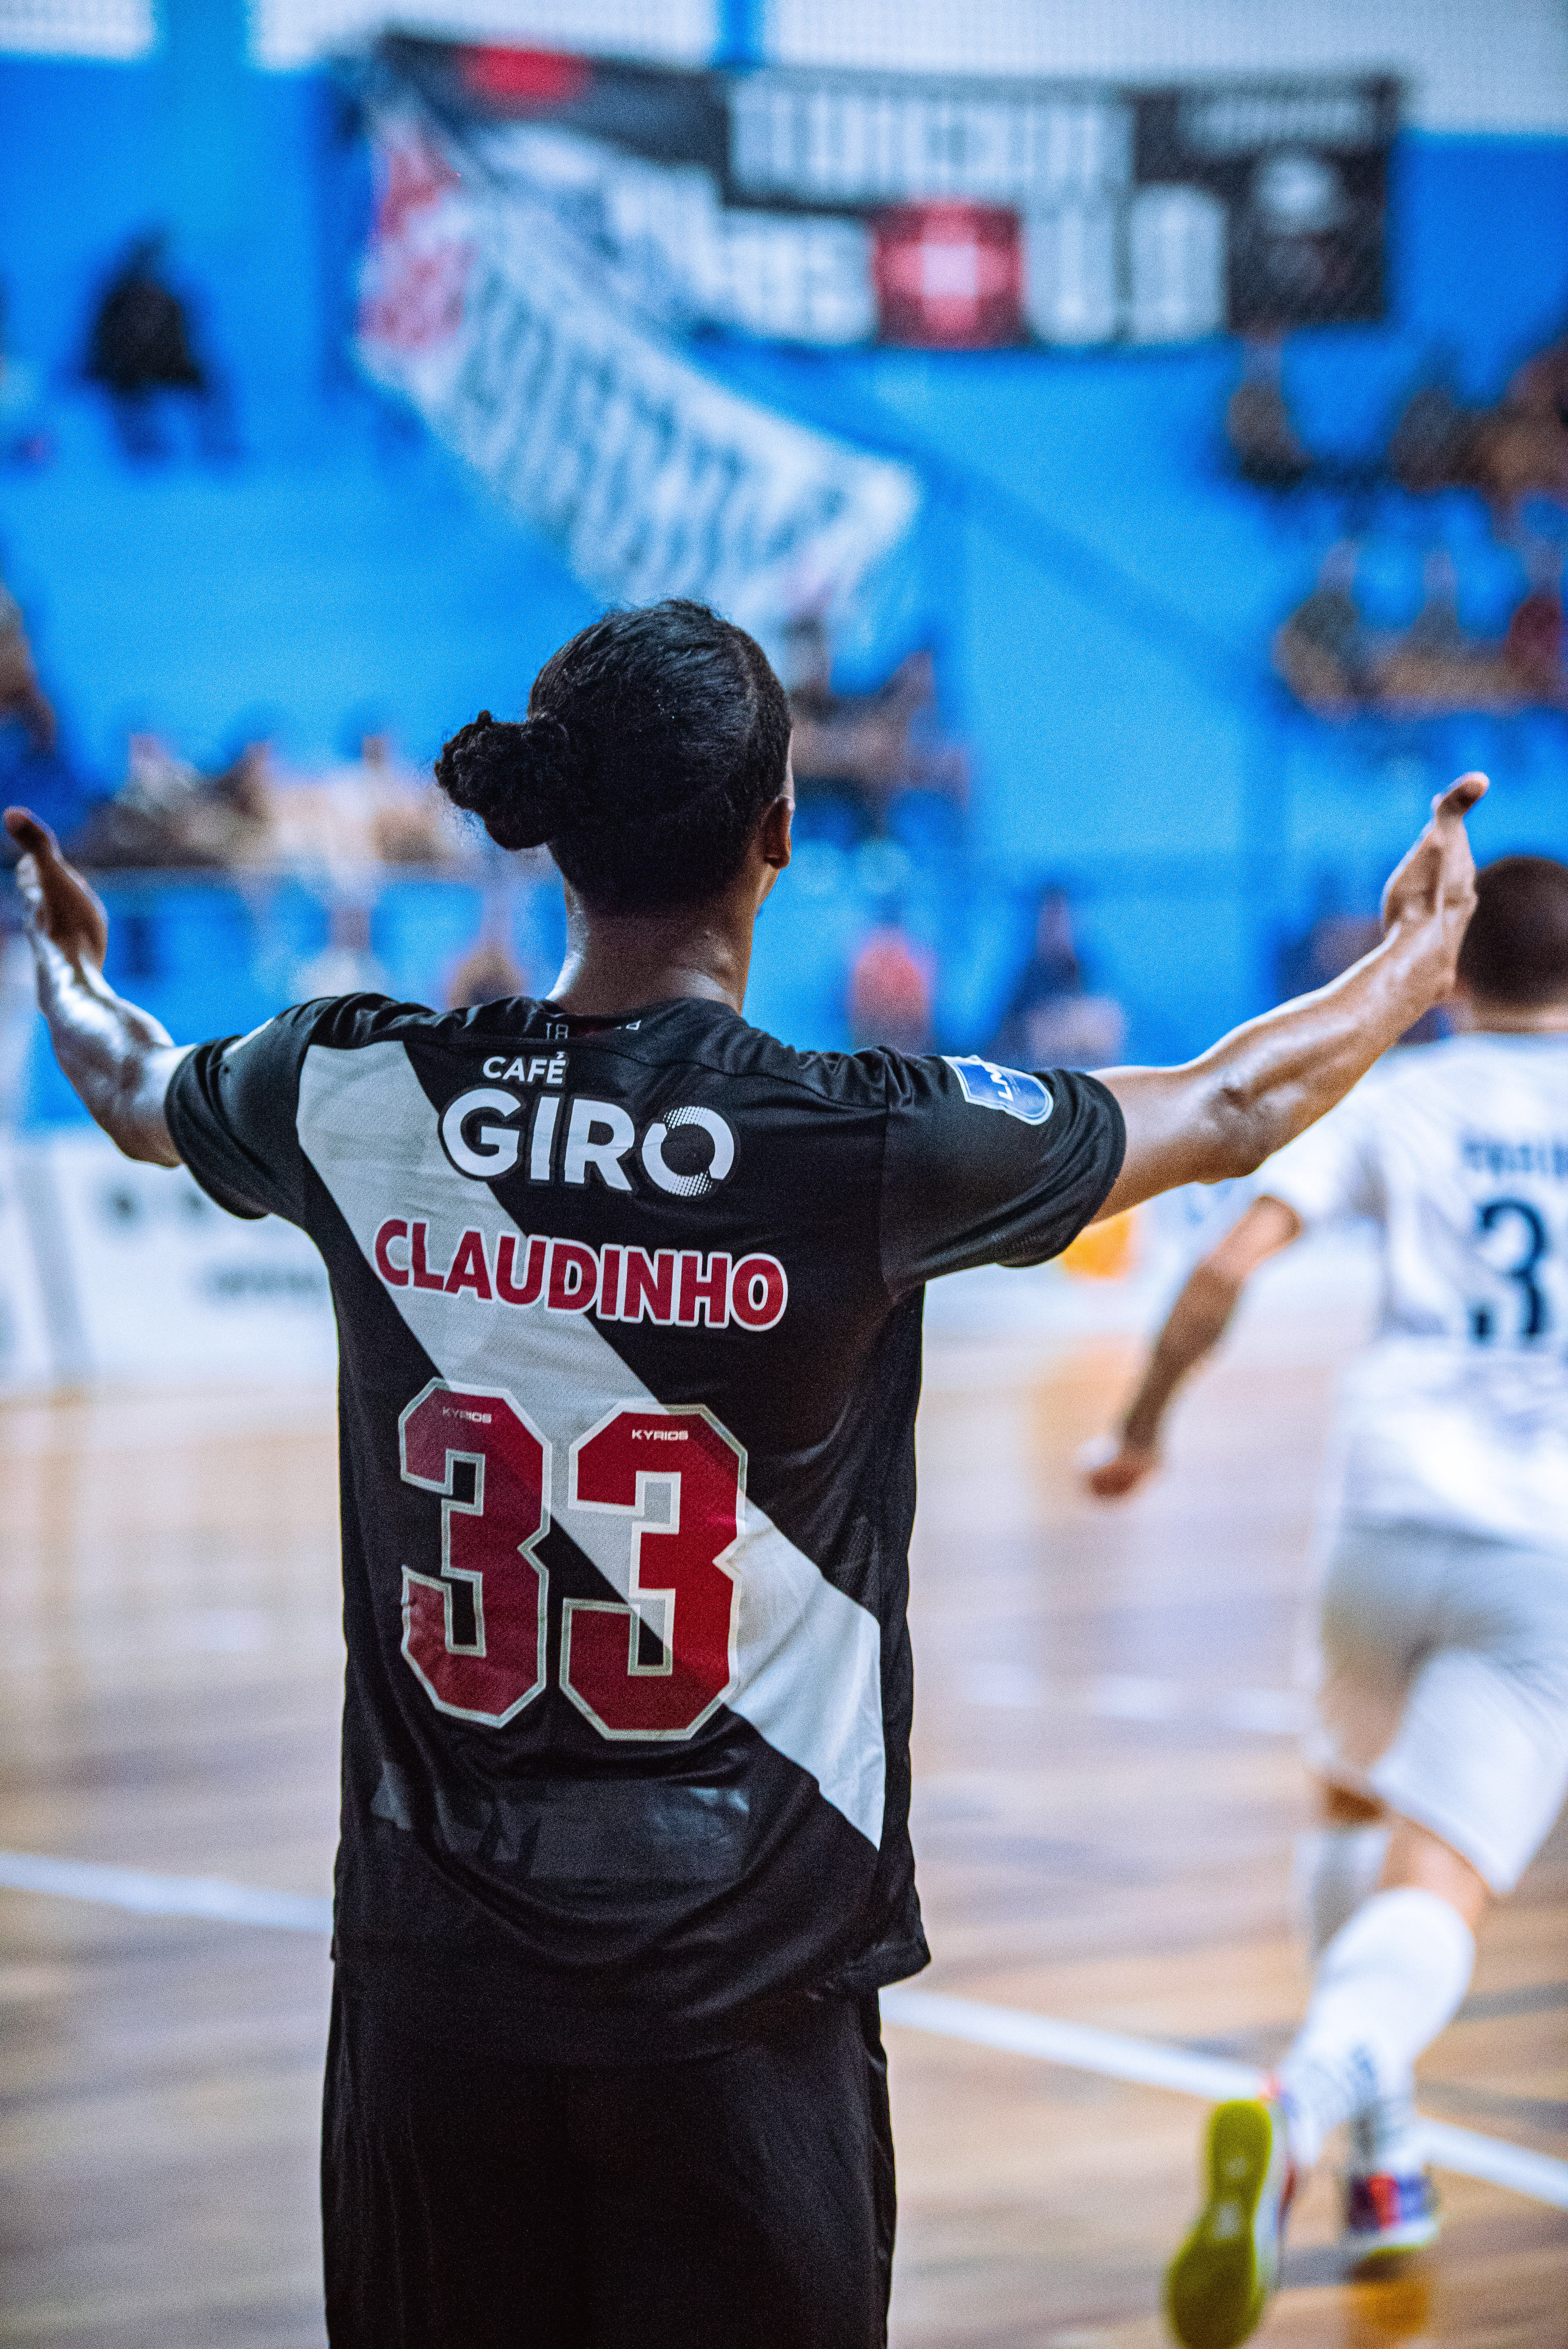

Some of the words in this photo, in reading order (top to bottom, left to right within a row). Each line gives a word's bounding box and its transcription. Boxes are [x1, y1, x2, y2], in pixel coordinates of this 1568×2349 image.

[483, 1052, 566, 1084] CAFÉ
[442, 1088, 735, 1197] GIRO
[374, 1219, 788, 1331] CLAUDINHO
[632, 1429, 688, 1440] KYRIOS
[399, 1377, 748, 1741] 33
